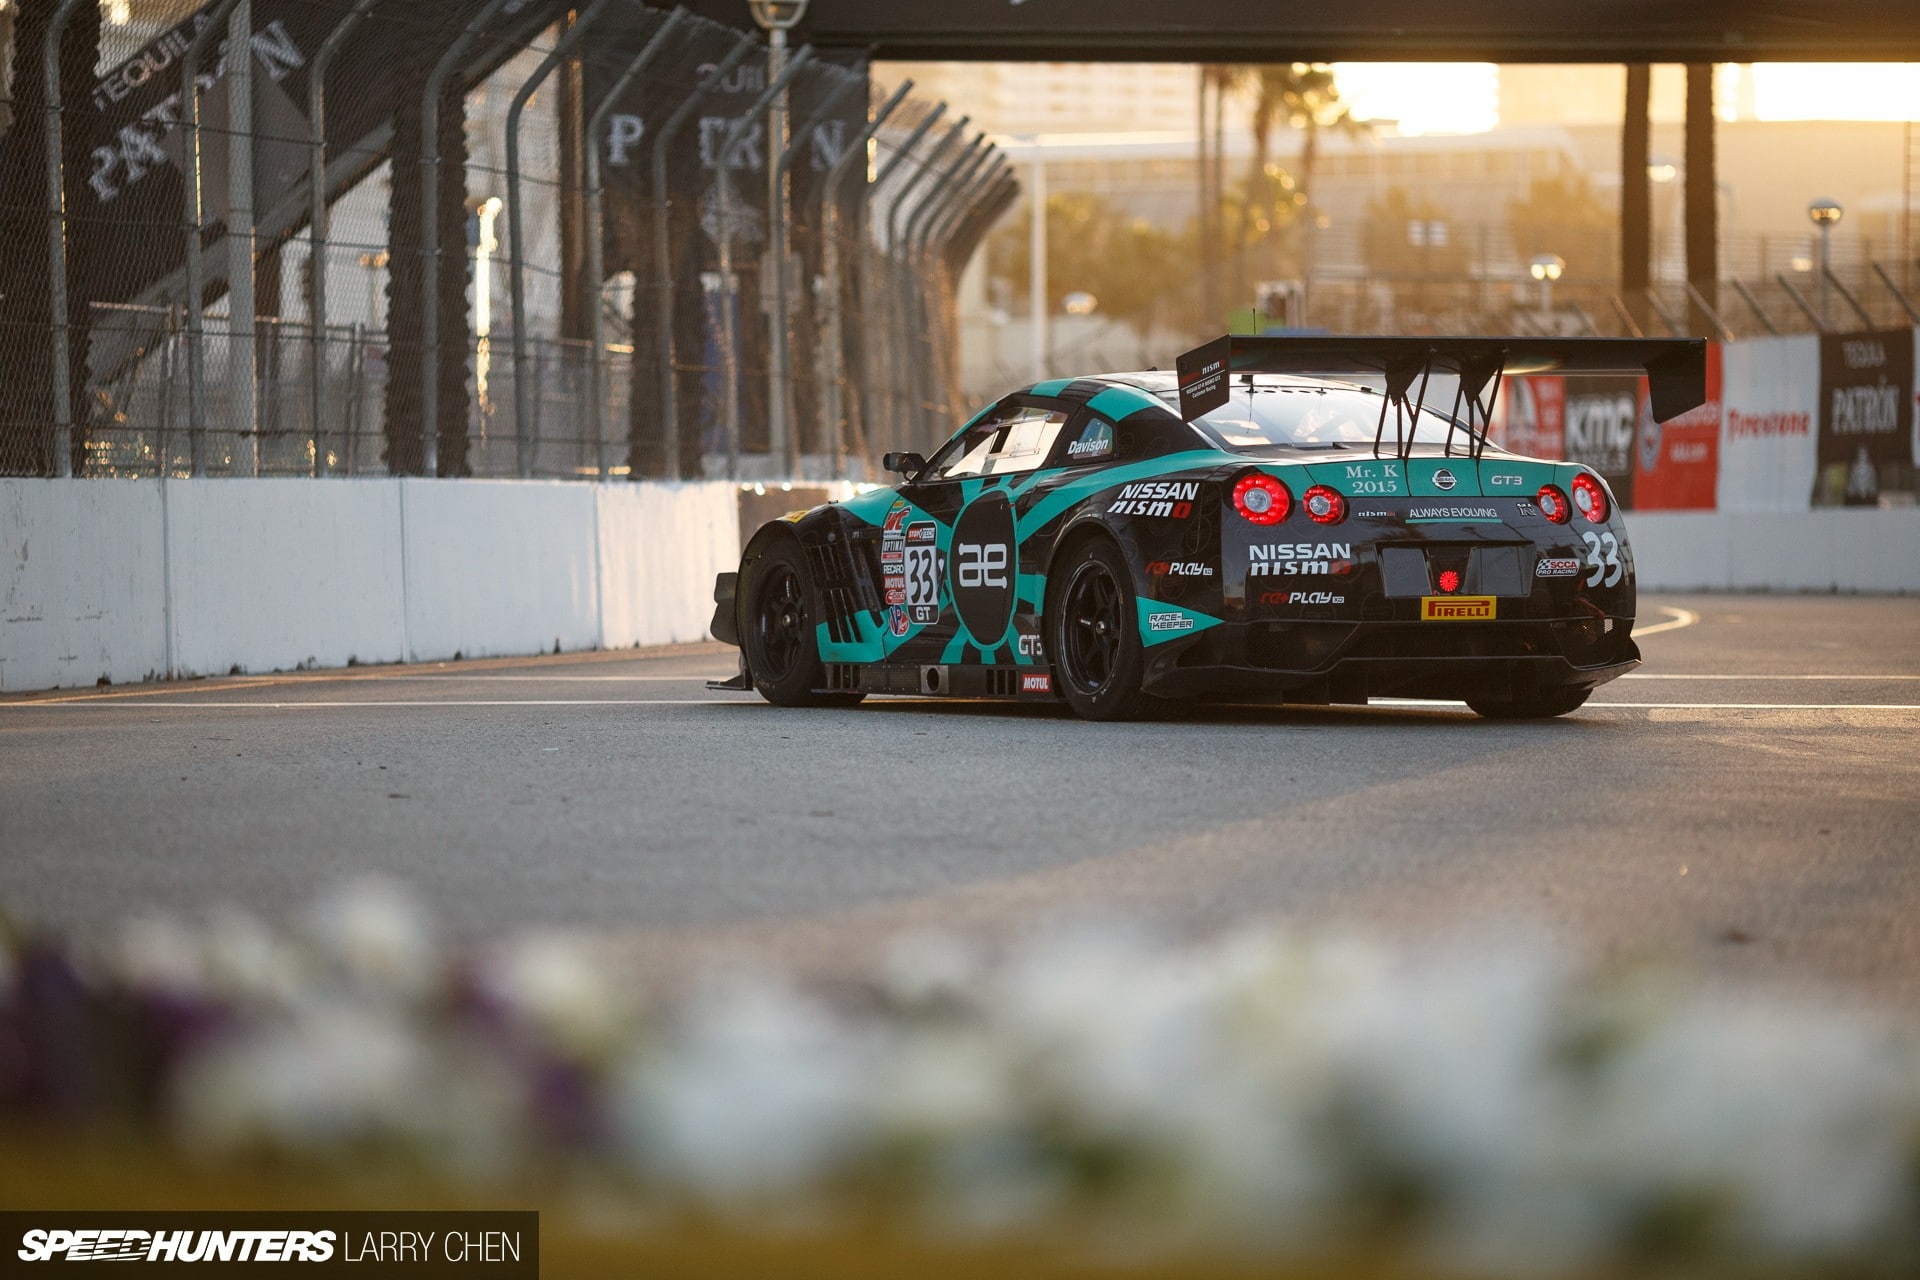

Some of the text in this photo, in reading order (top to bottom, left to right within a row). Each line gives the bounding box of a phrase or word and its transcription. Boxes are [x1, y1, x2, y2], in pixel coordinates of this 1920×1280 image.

[1067, 438, 1109, 455] Davison
[1346, 464, 1400, 479] Mr. K
[1352, 480, 1398, 494] 2015
[1491, 475, 1524, 486] GT3
[1118, 482, 1200, 501] NISSAN
[1106, 500, 1192, 519] nismo
[1409, 507, 1498, 518] ALWAYS EVOLVING
[1249, 543, 1351, 561] NISSAN
[1582, 531, 1624, 588] 33
[1250, 560, 1351, 577] nismo
[1550, 561, 1577, 569] SCCA
[884, 577, 905, 589] MOTUL
[909, 549, 934, 604] 33
[915, 606, 931, 621] GT
[1427, 600, 1491, 617] PIRELLI
[1152, 620, 1193, 630] KEEPER
[1023, 676, 1049, 690] MOTUL
